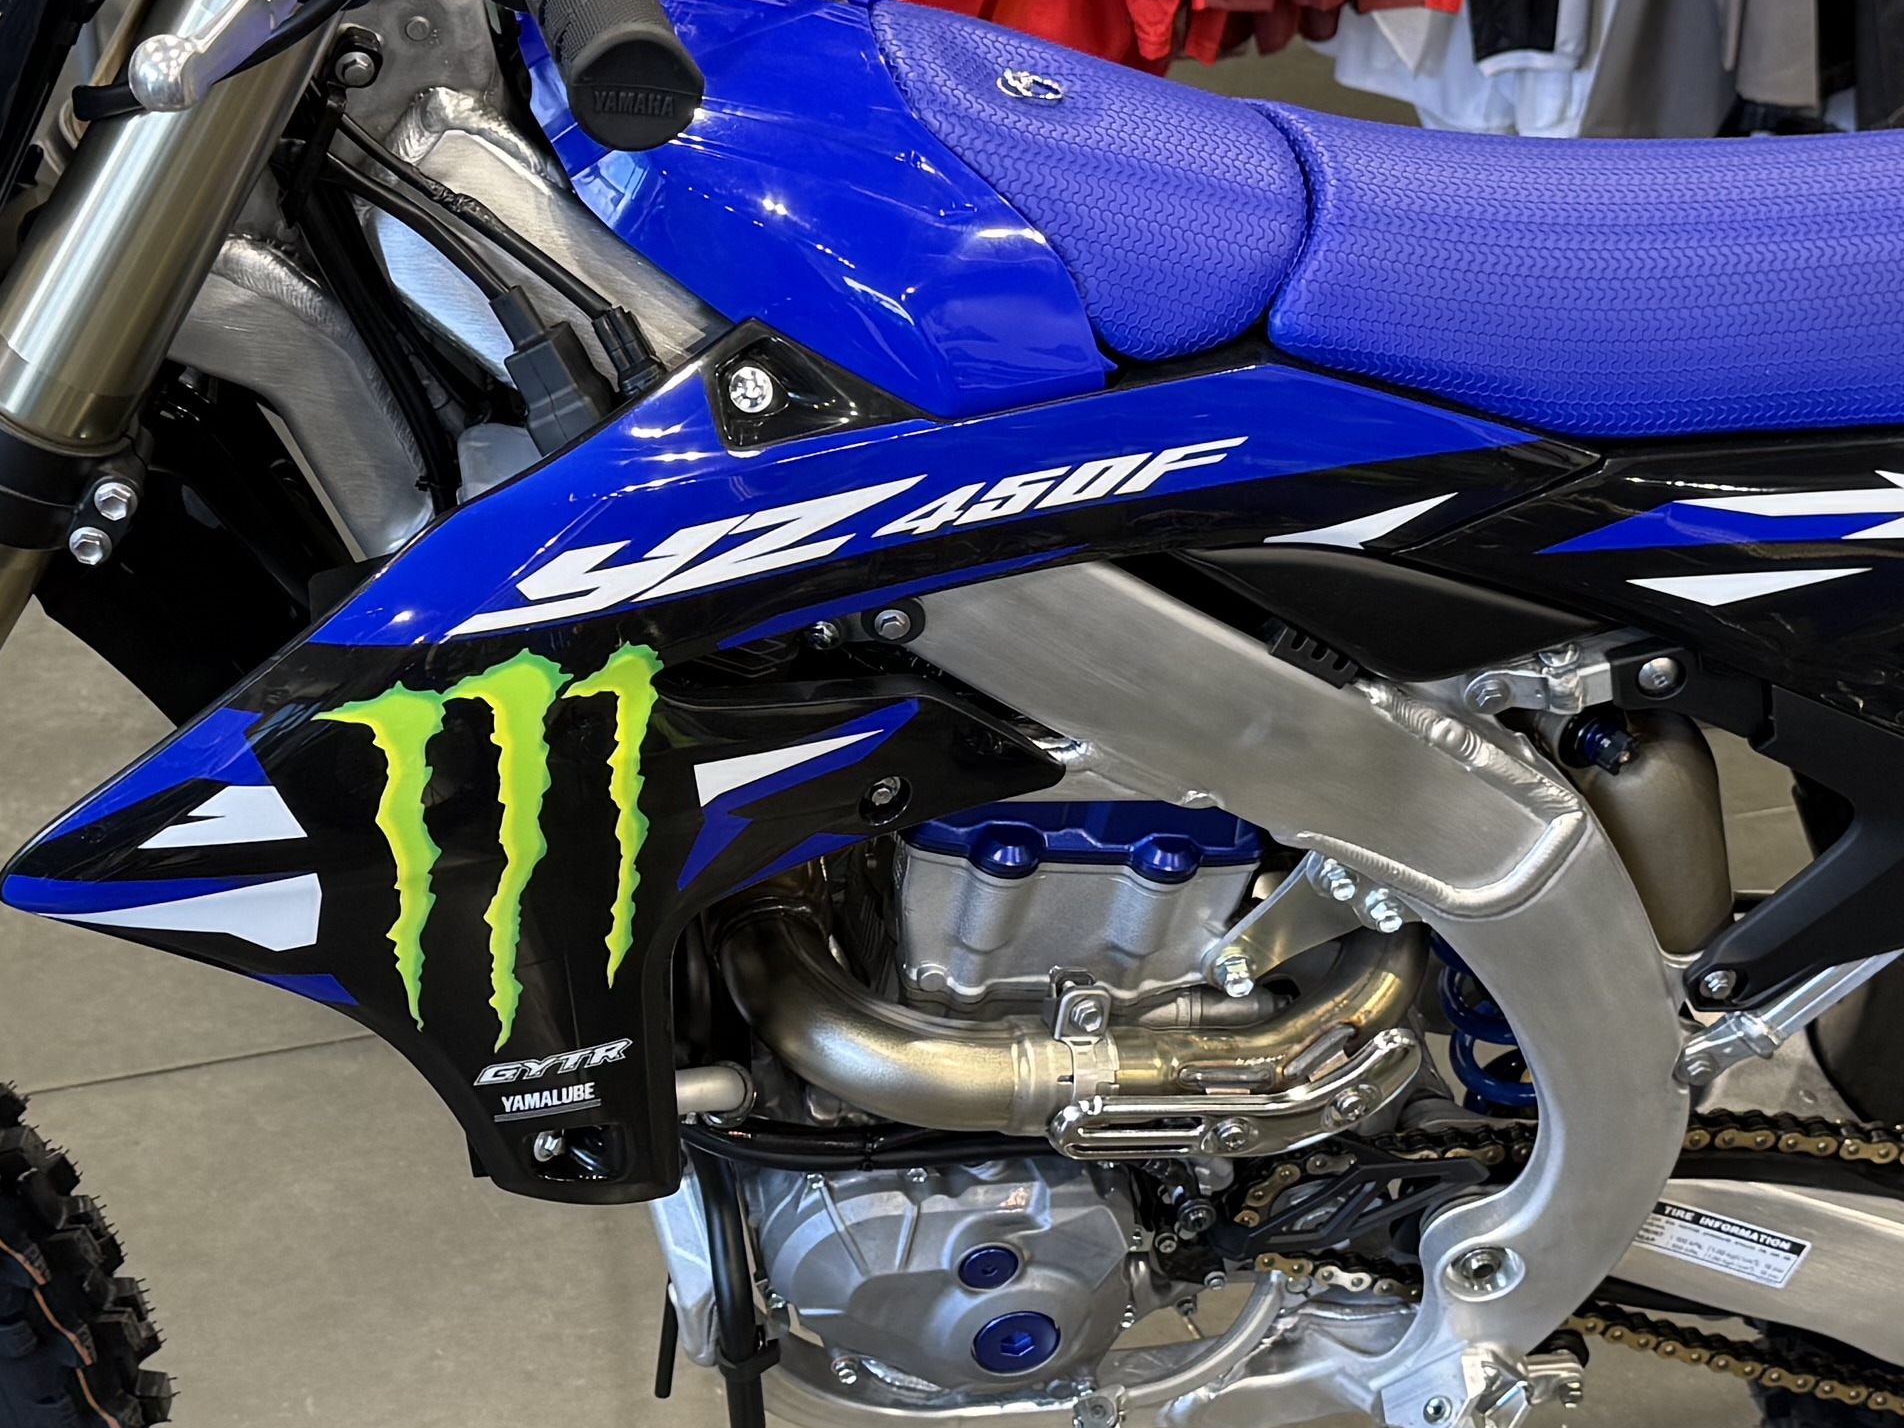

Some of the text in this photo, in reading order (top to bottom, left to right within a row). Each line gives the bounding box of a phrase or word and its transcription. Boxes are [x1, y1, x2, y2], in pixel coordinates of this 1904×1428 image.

[593, 90, 673, 117] YAMAHA
[443, 436, 1249, 642] YZ 450F
[474, 1038, 633, 1085] GYTR
[501, 1083, 596, 1113] YAMALUBE
[1662, 1205, 1695, 1221] TIRE
[1697, 1215, 1793, 1250] INFORMATION
